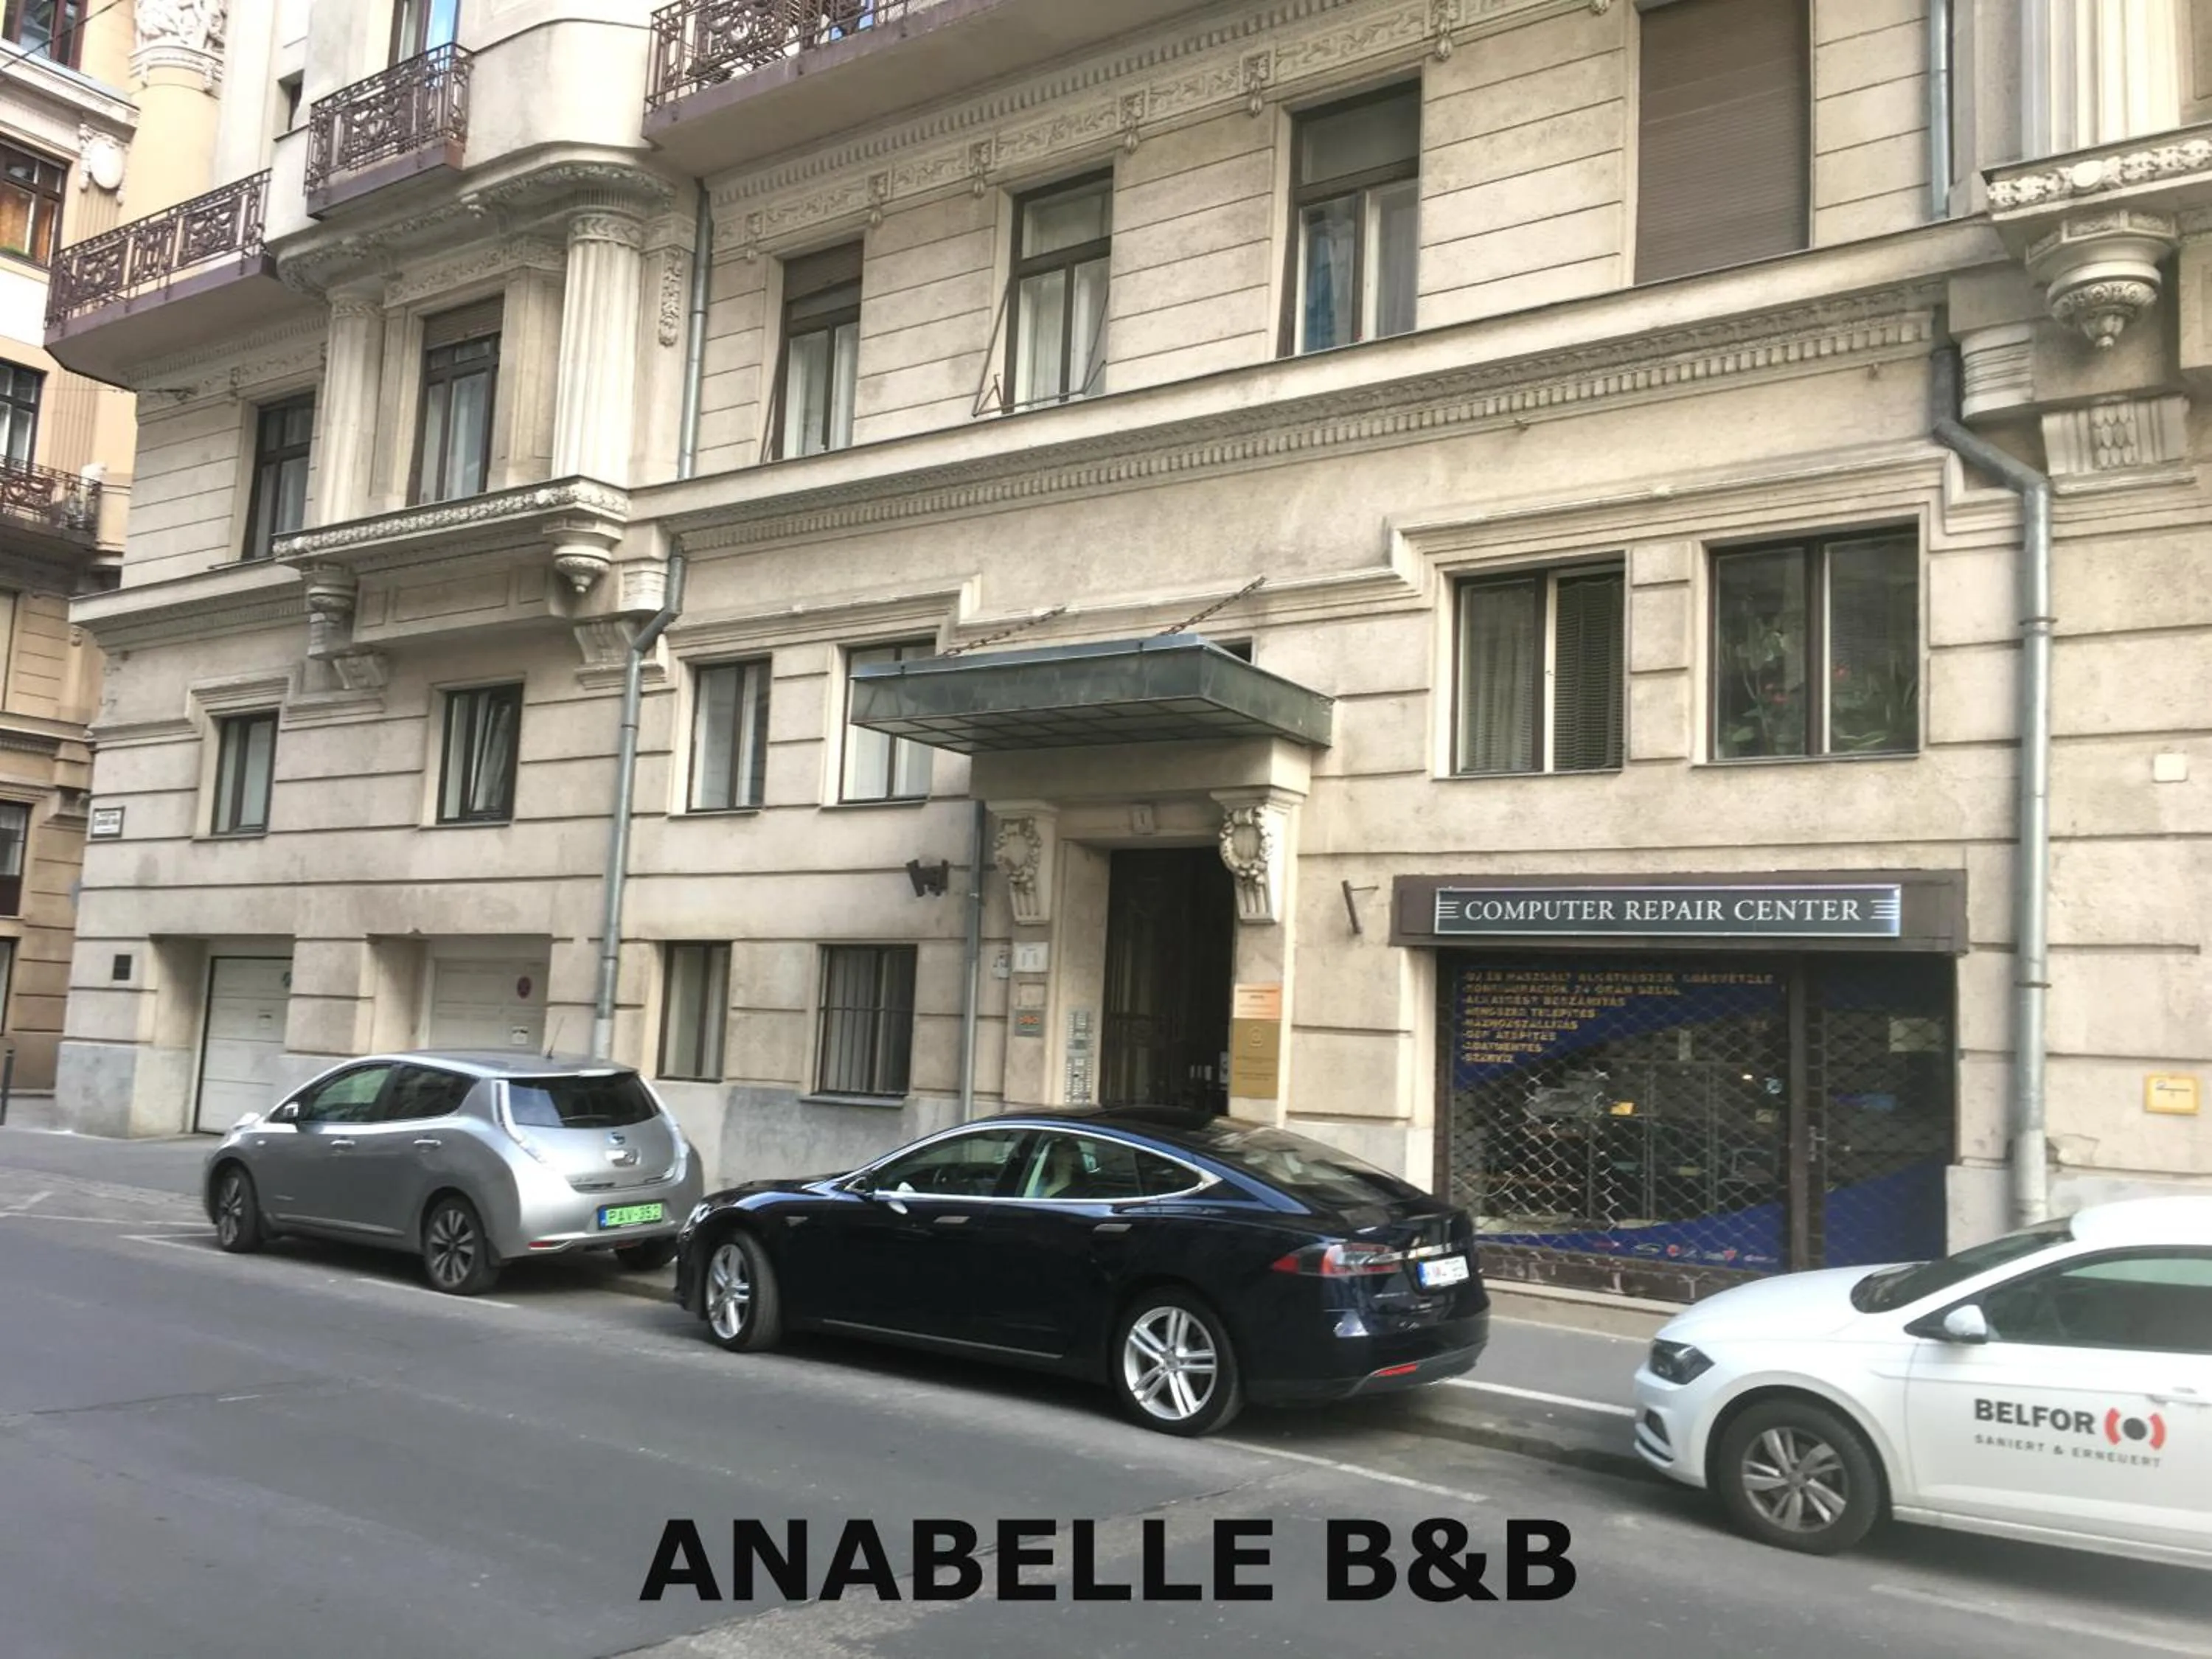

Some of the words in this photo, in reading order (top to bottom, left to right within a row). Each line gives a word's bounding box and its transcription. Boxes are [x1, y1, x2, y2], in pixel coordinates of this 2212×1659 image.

[1464, 900, 1616, 921] COMPUTER
[1624, 900, 1725, 921] REPAIR
[1733, 900, 1862, 921] CENTER
[1974, 1398, 2096, 1435] BELFOR
[1974, 1433, 2045, 1453] SANIERT
[2053, 1445, 2065, 1455] &
[2072, 1447, 2161, 1468] ERNEUERT
